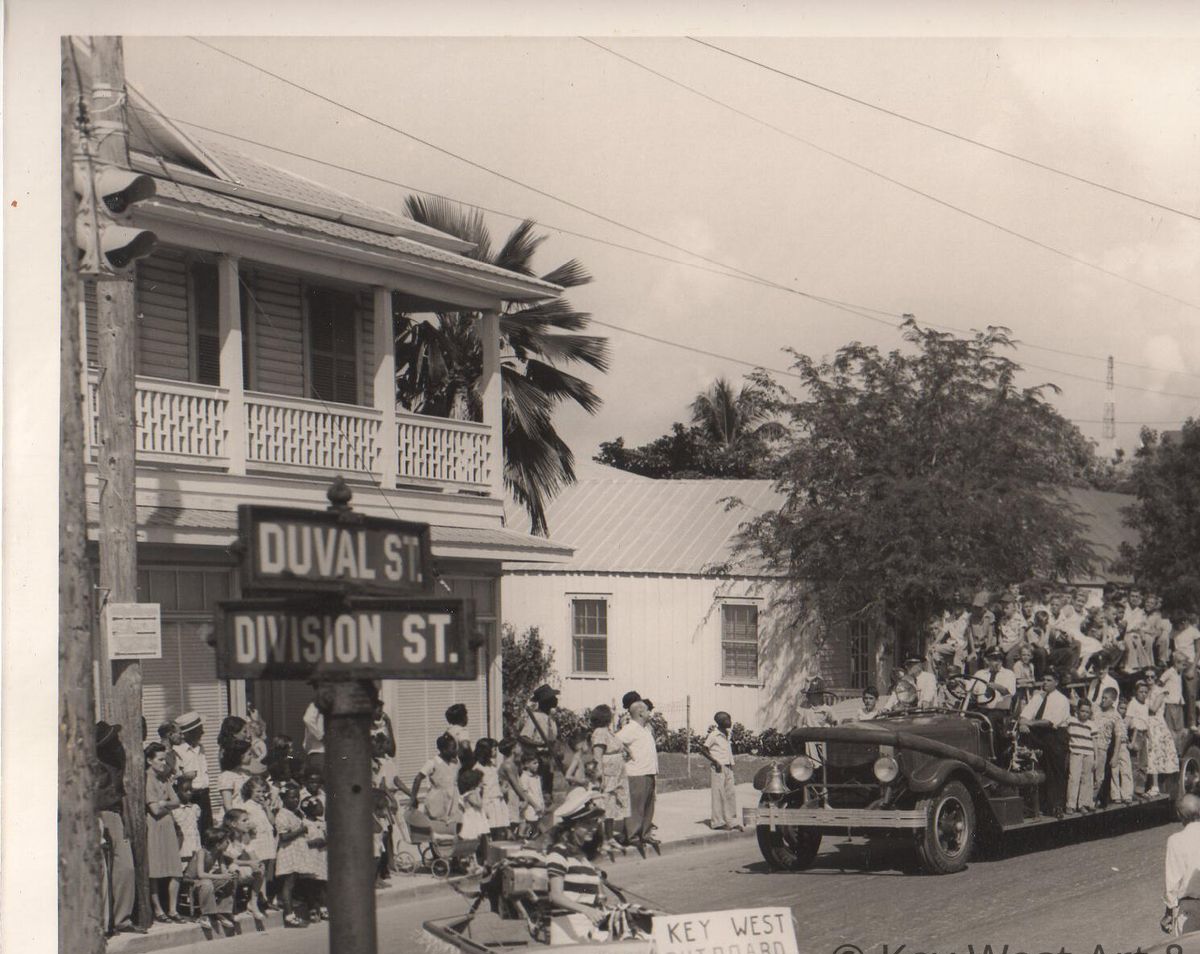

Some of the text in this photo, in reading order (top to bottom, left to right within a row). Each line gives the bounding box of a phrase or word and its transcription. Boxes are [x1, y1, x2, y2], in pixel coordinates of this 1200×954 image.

[258, 522, 423, 583] DUVAL ST.
[234, 613, 459, 664] DIVISION ST.
[667, 914, 784, 943] KEY WEST
